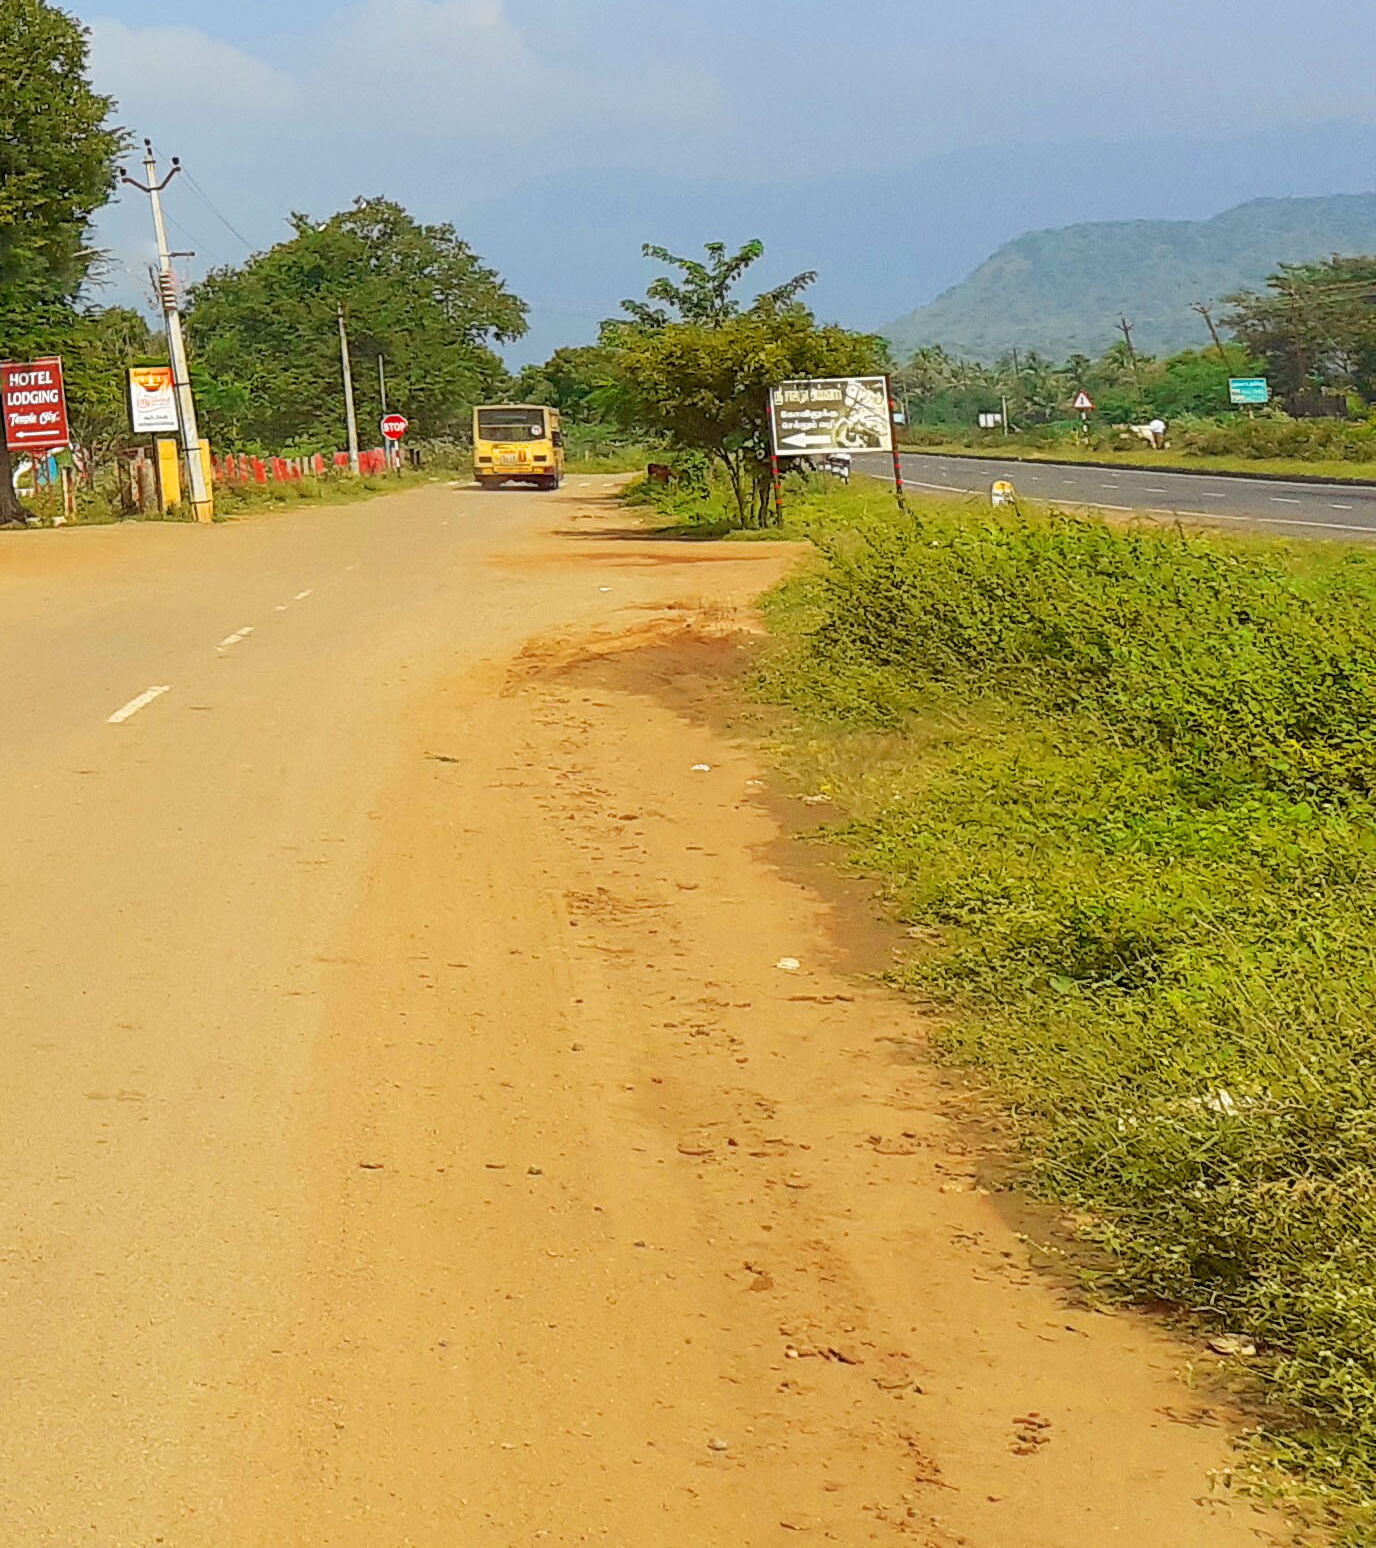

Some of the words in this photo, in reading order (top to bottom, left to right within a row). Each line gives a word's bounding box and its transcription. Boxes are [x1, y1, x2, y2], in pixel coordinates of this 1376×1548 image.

[9, 371, 53, 386] HOTEL
[8, 389, 58, 406] LODGING
[383, 422, 405, 432] STOP
